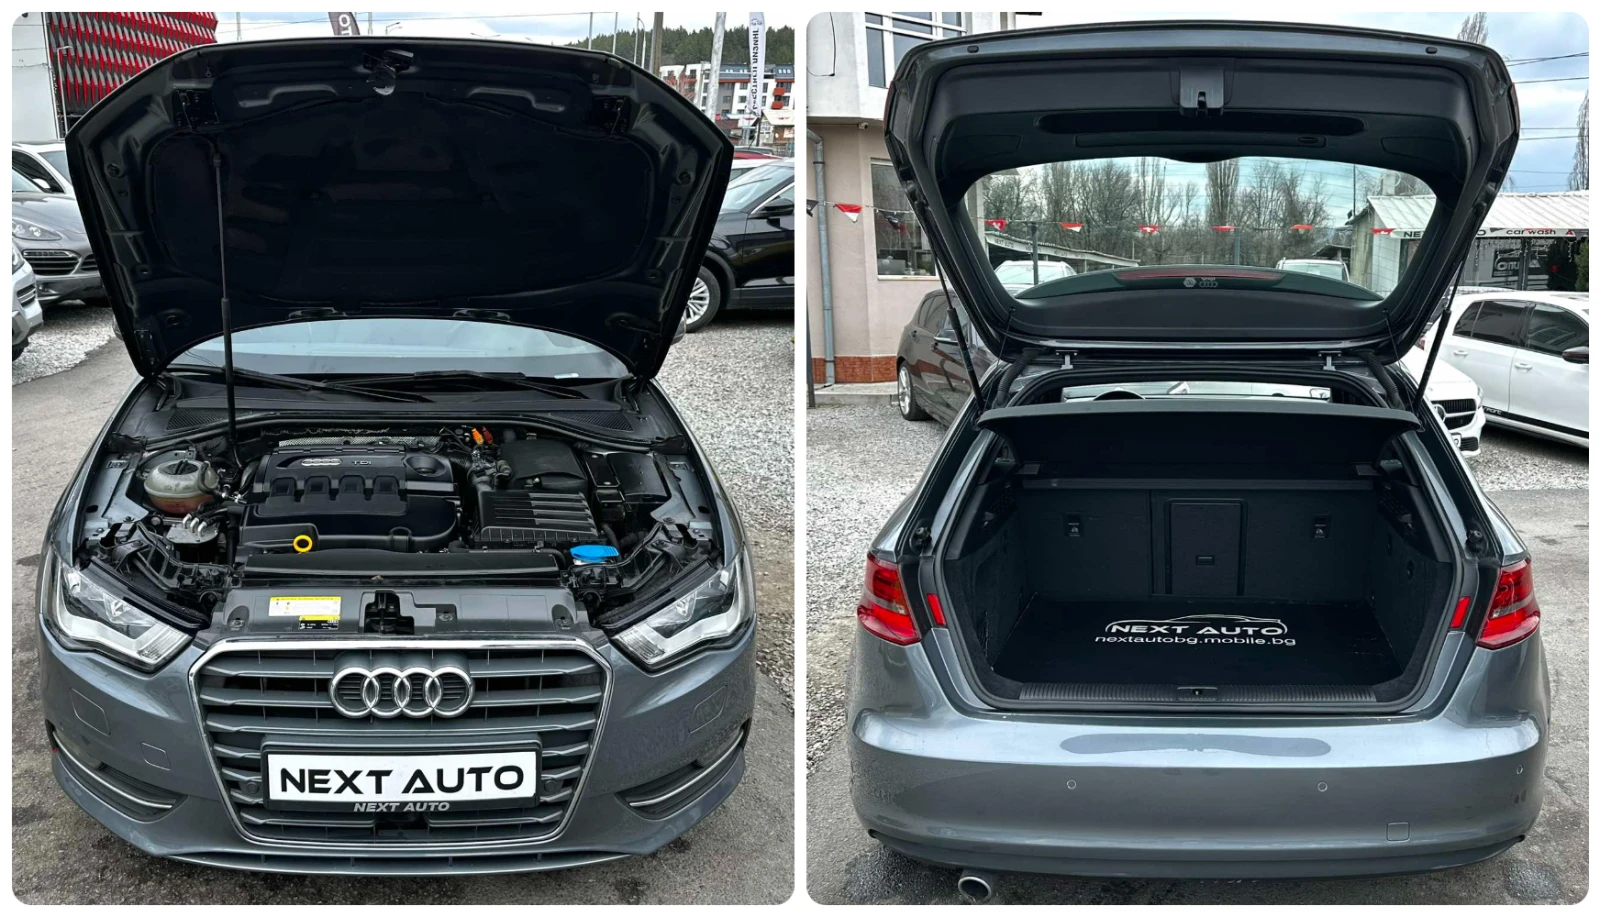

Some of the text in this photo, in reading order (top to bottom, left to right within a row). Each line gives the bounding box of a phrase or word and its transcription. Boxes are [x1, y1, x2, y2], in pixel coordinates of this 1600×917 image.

[1111, 625, 1283, 635] NEXT AUTO
[1094, 635, 1296, 646] nextautobg.mobile.bg
[280, 765, 524, 795] NEXT AUTO
[353, 801, 450, 813] NEXT AUTO
